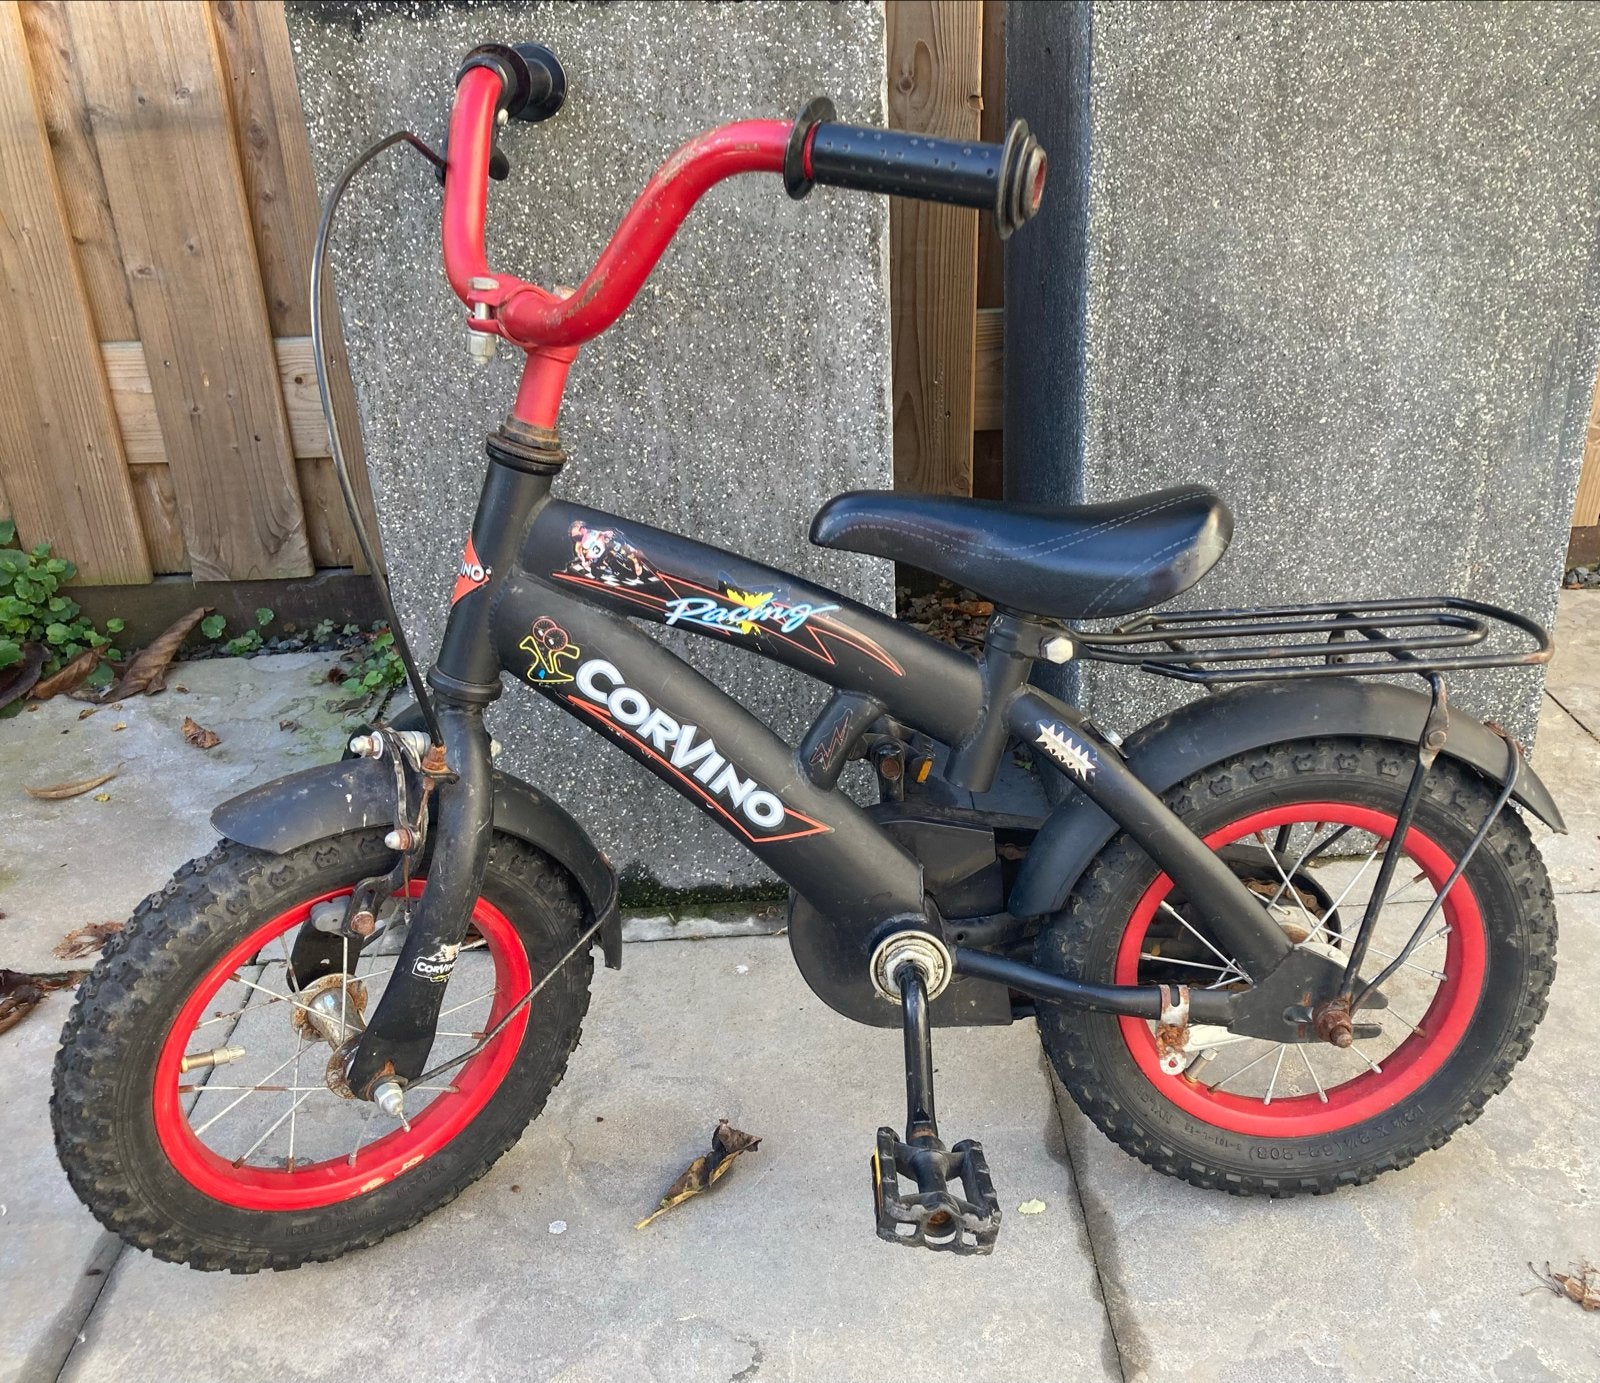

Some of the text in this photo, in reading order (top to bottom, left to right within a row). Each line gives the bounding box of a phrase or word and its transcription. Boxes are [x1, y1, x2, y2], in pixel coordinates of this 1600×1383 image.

[665, 597, 841, 635] Racing
[575, 658, 786, 828] CORVINO
[416, 961, 455, 974] CORVIN
